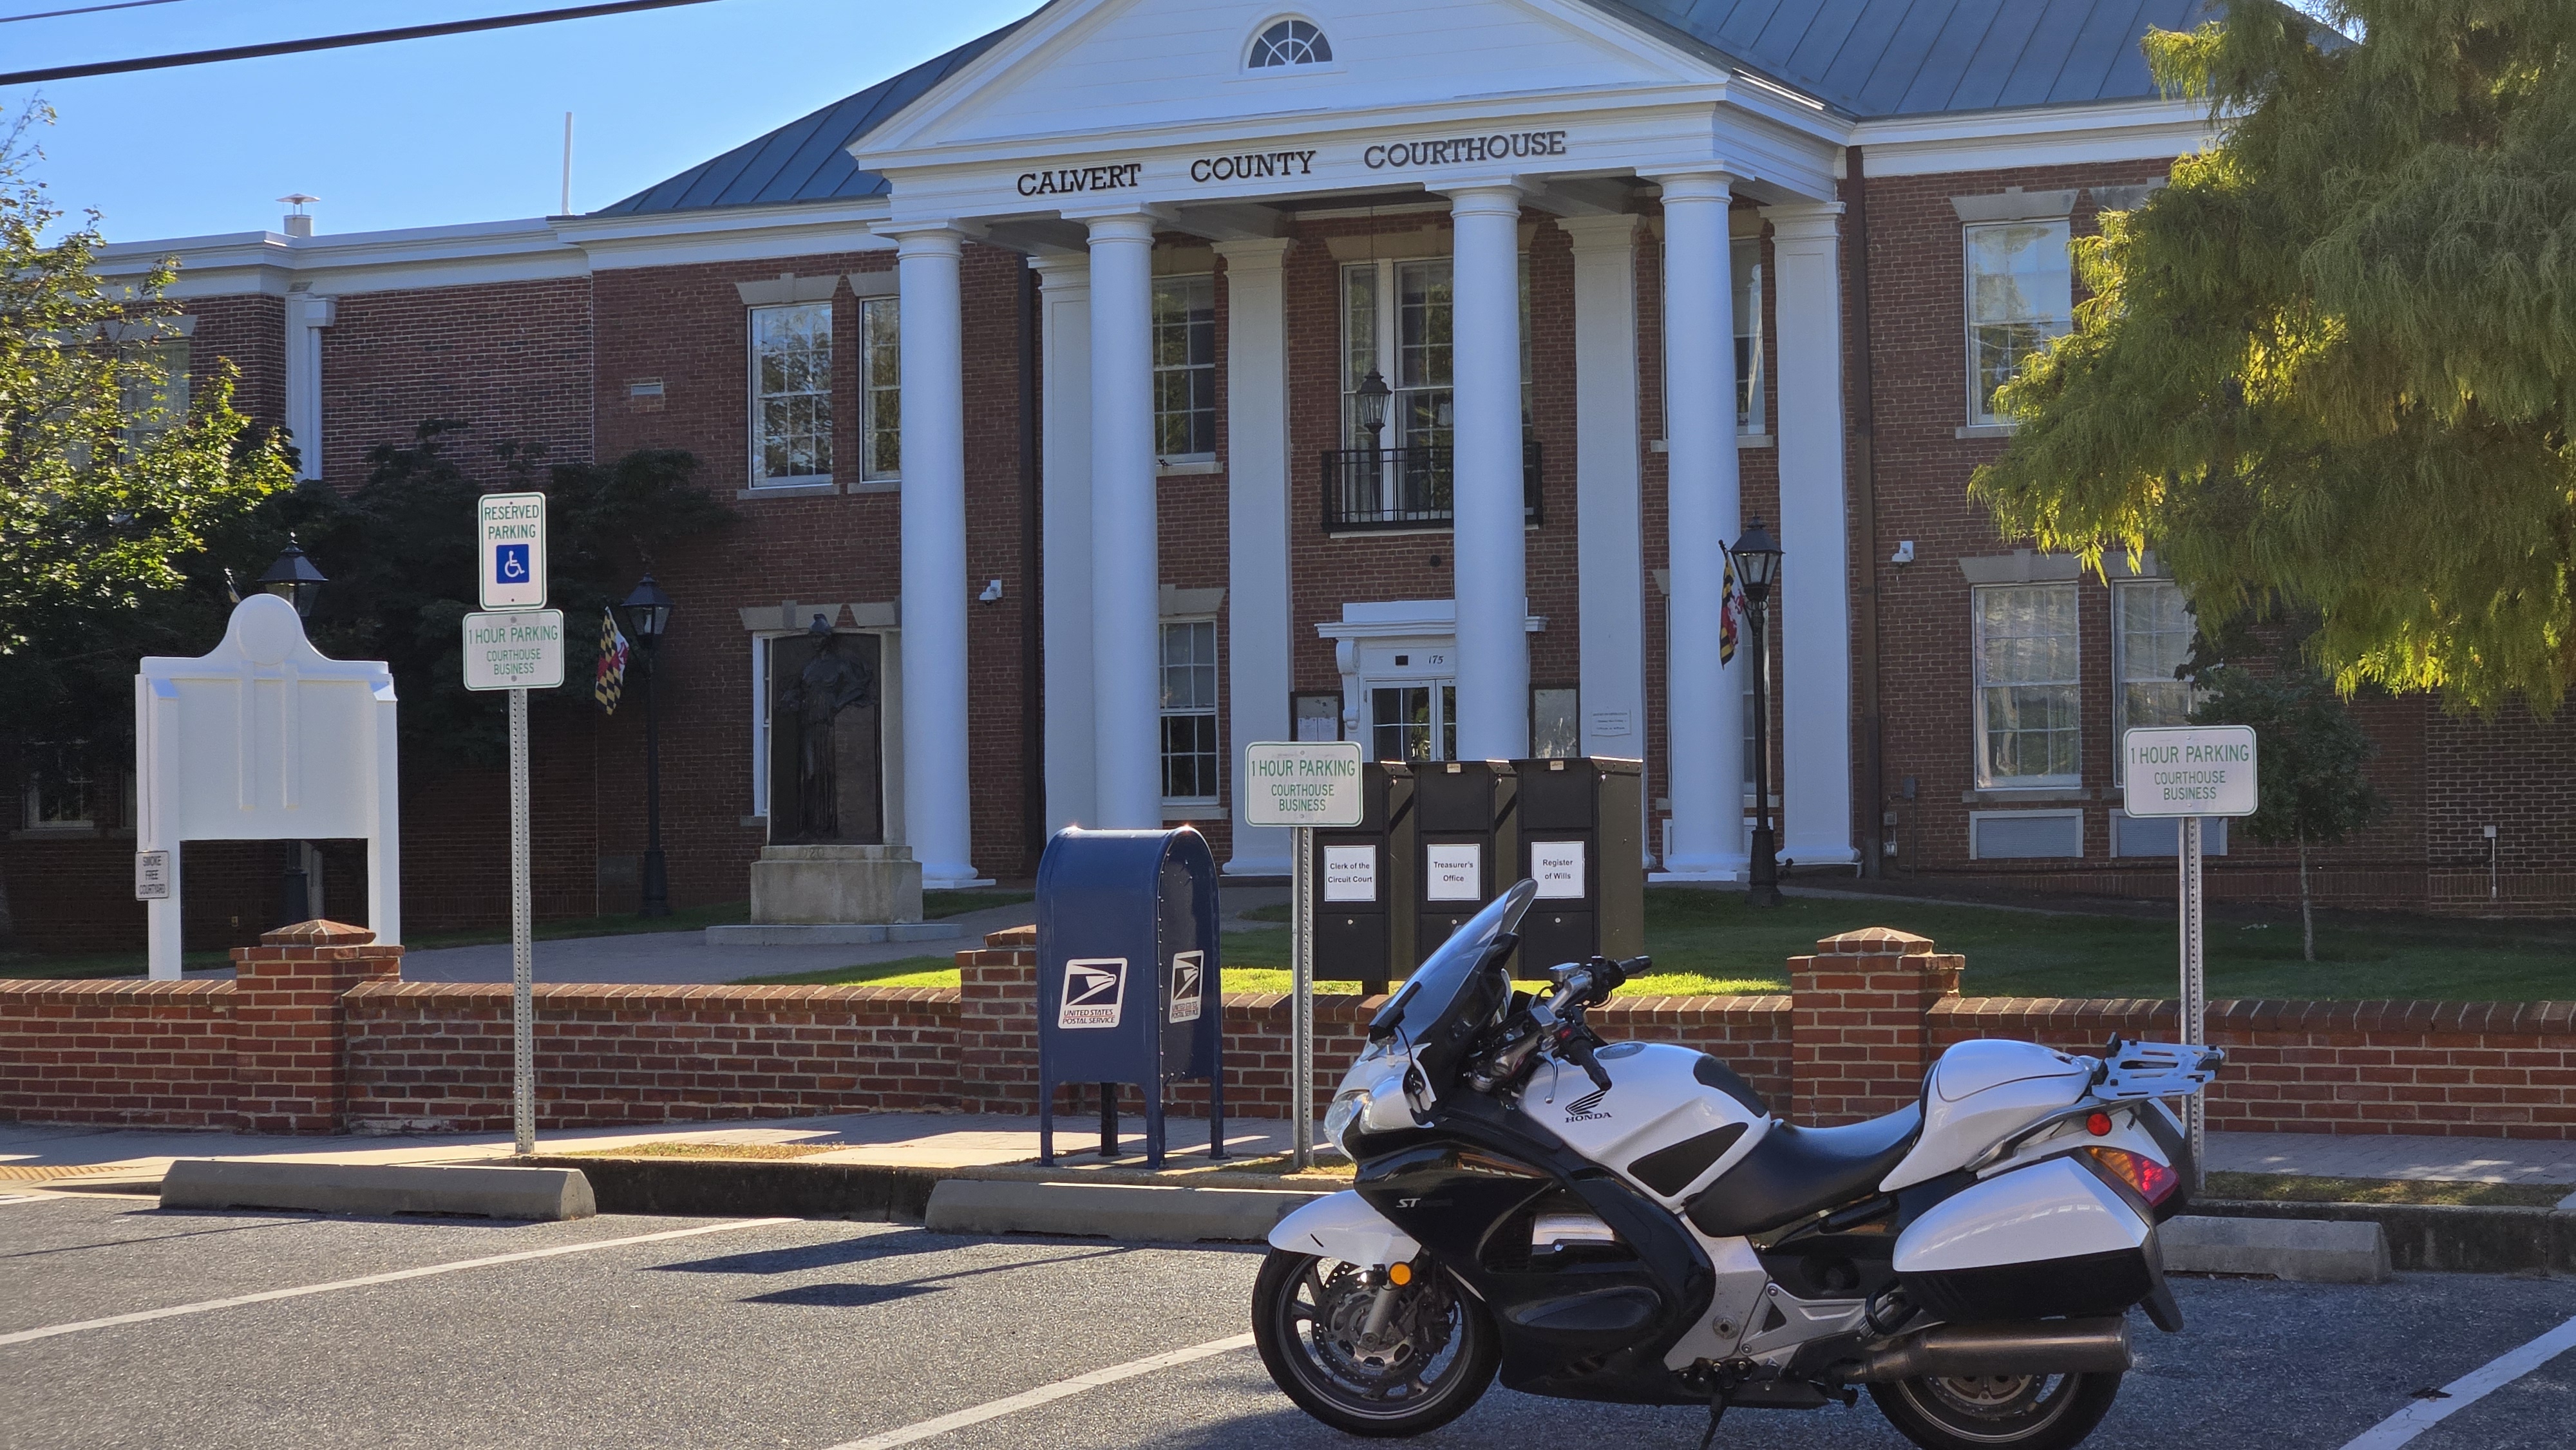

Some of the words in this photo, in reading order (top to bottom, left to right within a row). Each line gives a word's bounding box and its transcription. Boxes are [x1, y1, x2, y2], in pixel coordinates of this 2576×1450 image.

[1016, 163, 1142, 196] CALVERT
[1190, 149, 1317, 183] COUNTY
[1364, 131, 1566, 169] COURTHOUSE
[484, 505, 539, 520] RESERVED
[488, 524, 536, 540] PARKING
[469, 630, 473, 645] 1
[475, 628, 506, 644] HOUR
[511, 625, 558, 643] PARKING
[486, 648, 541, 662] COURTHOUSE
[1429, 655, 1444, 664] 175
[494, 663, 535, 675] BUSINESS
[2131, 748, 2135, 764] 1
[2140, 746, 2179, 764] HOUR
[2186, 744, 2249, 762] PARKING
[1252, 760, 1255, 777] 1
[1260, 760, 1293, 777] HOUR
[1300, 760, 1355, 777] PARKING
[2154, 771, 2226, 785] COURTHOUSE
[1271, 784, 1334, 796] COURTHOUSE
[2164, 786, 2217, 800] BUSINESS
[1279, 798, 1326, 811] BUSINESS
[1543, 859, 1573, 867] Register
[145, 869, 158, 880] FREE
[1565, 1112, 1613, 1123] HONDA
[1396, 1198, 1421, 1208] ST
